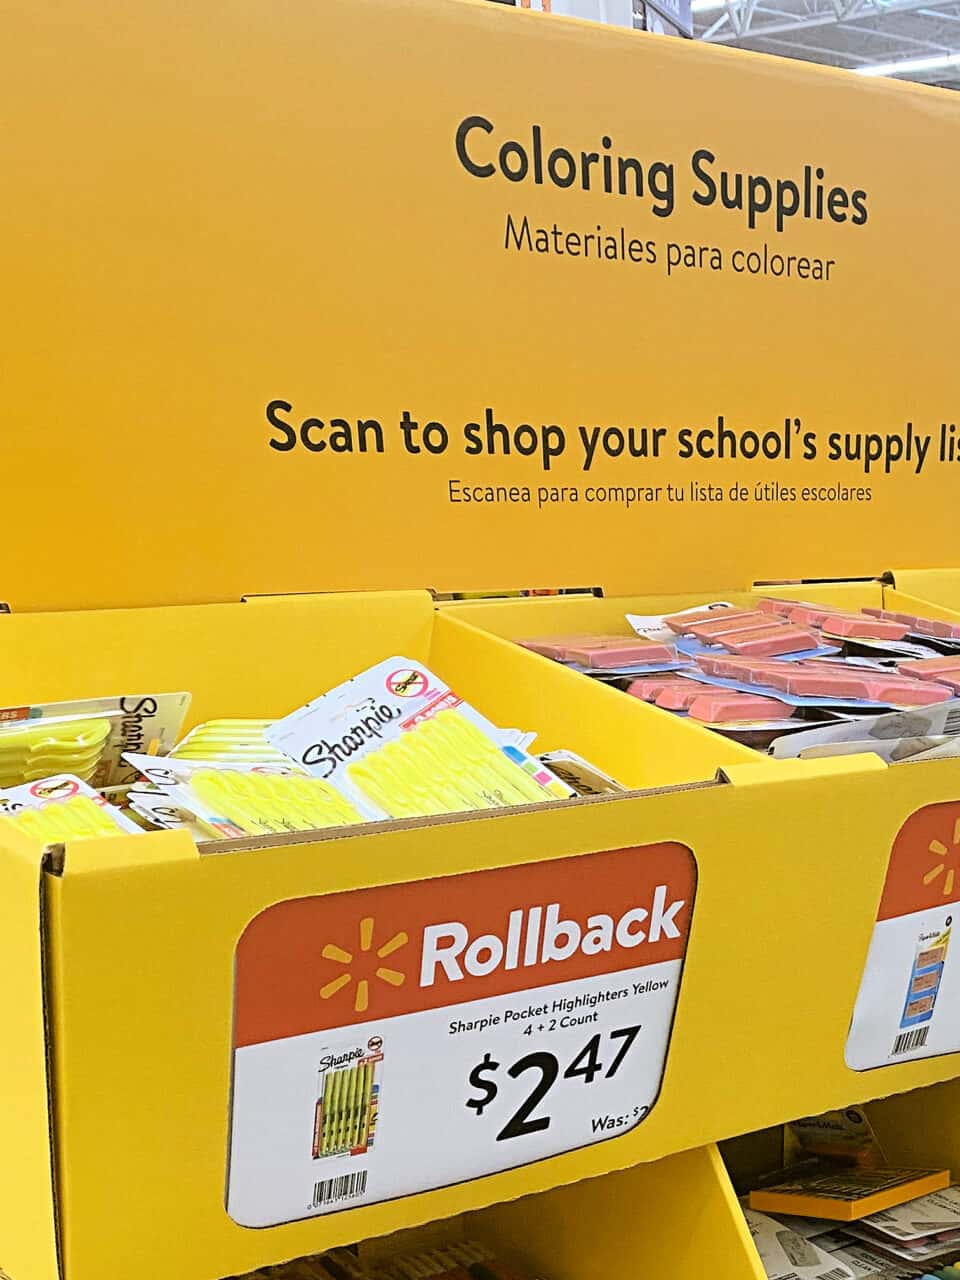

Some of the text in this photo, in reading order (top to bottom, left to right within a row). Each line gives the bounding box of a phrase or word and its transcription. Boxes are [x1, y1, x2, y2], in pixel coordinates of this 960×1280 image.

[454, 114, 869, 231] Coloring Supplies
[504, 216, 834, 281] Materiales para colorear
[265, 400, 385, 455] Scan
[401, 412, 449, 454] to
[464, 409, 566, 470] shop
[579, 423, 667, 472] your
[678, 417, 817, 462] school's
[828, 423, 930, 473] supply
[449, 480, 872, 507] Escanea para comprar tu lista de útiles escolares
[302, 701, 402, 779] Sharpie
[420, 885, 685, 988] Rollback
[449, 978, 669, 1036] Sharpie Pocket Highlighters Yellow
[524, 1011, 598, 1036] 4 2 Count
[318, 1046, 364, 1074] Sharpie
[591, 1113, 629, 1135] Was:
